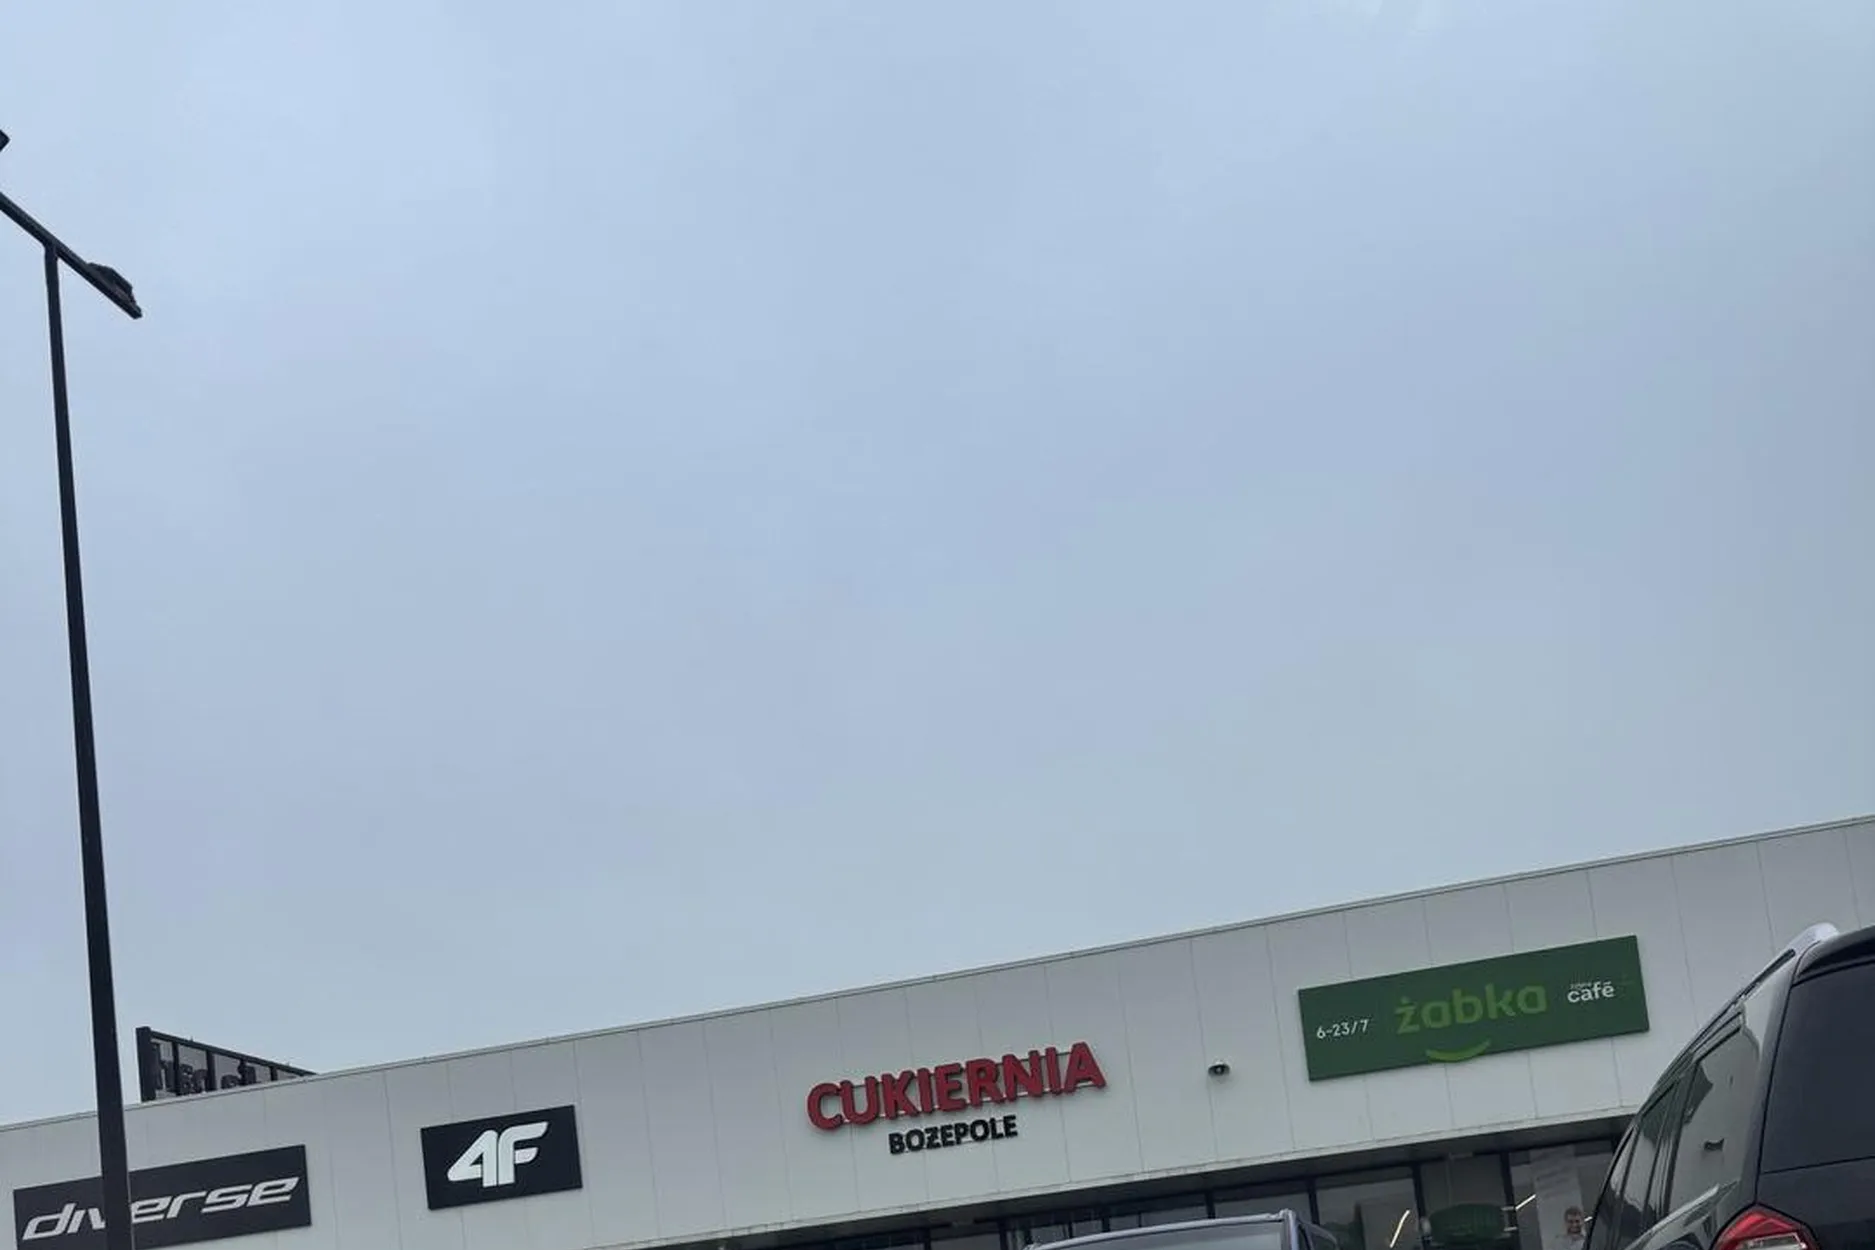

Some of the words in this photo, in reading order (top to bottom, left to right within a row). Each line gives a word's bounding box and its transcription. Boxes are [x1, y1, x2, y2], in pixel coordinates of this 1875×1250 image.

[1395, 982, 1548, 1034] żabka
[1567, 980, 1615, 1003] café
[1316, 1018, 1370, 1040] 6-23/7
[806, 1041, 1107, 1131] CUKIERNIA
[447, 1121, 549, 1188] 4F
